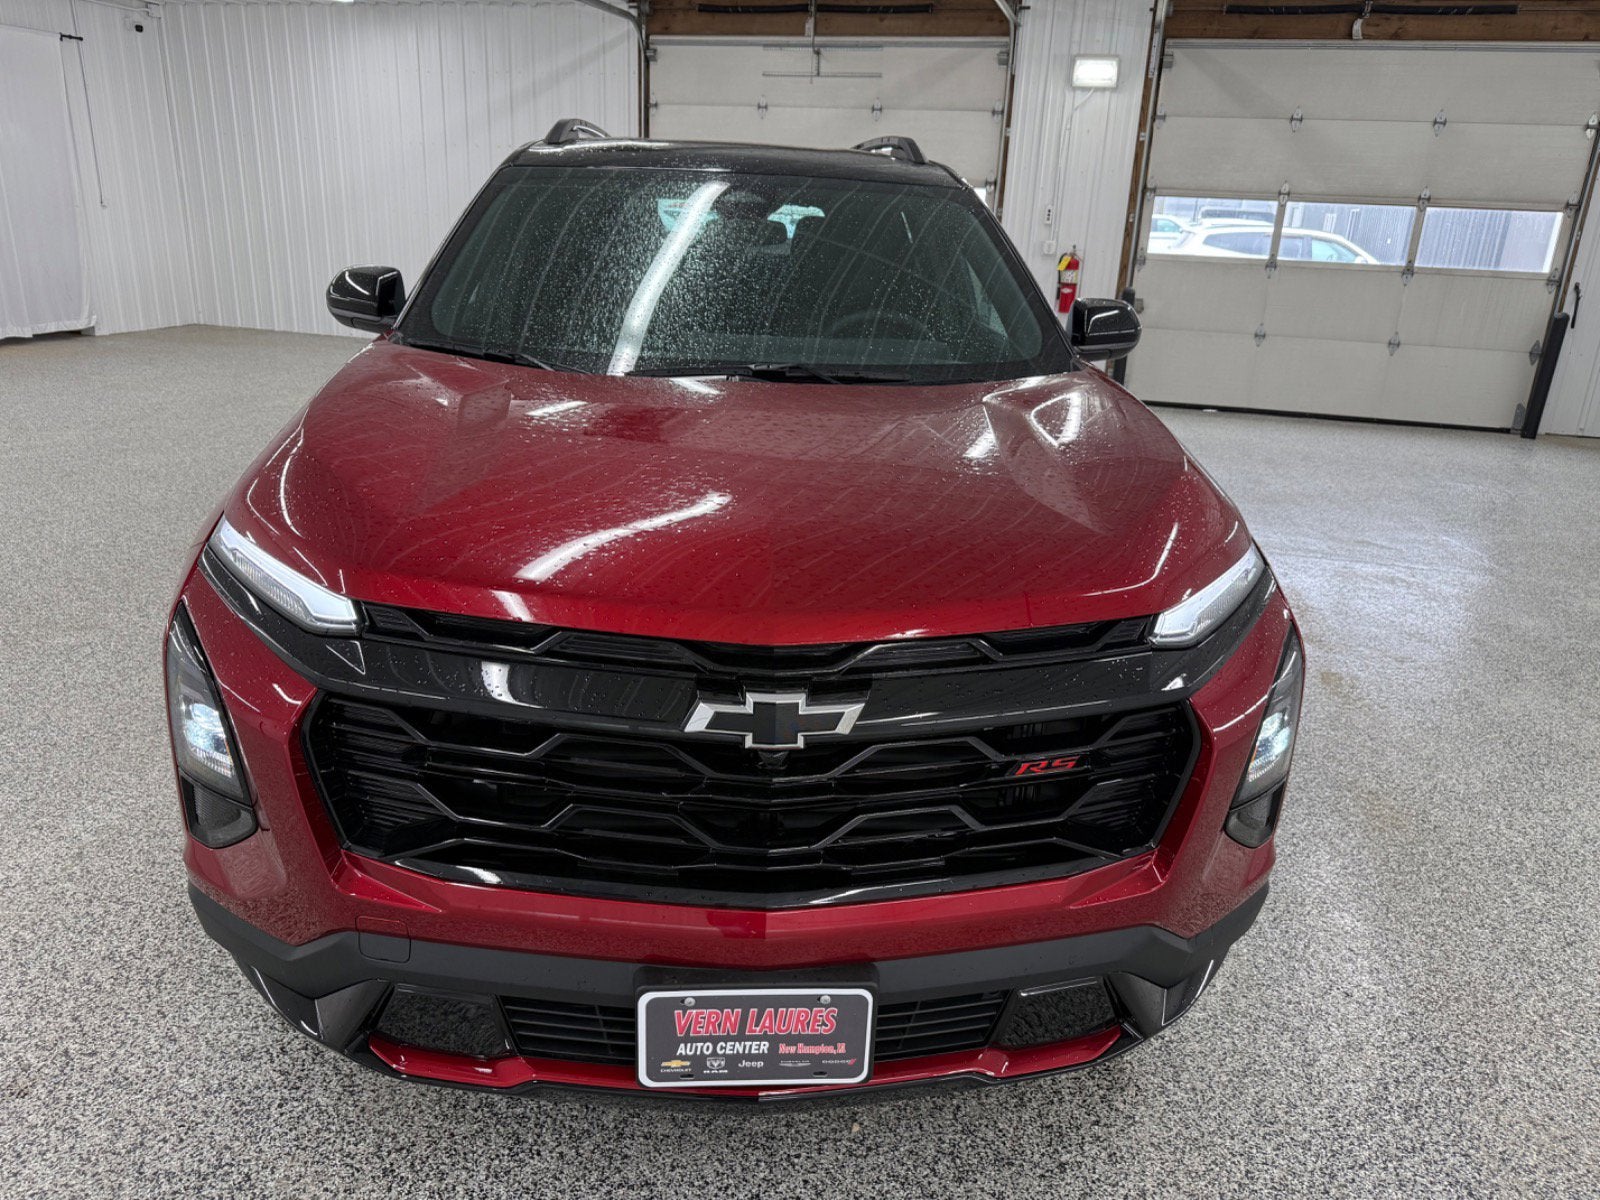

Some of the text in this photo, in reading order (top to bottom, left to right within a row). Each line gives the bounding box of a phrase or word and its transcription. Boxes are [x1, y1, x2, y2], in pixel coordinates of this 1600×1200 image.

[1015, 756, 1080, 775] RS
[674, 1007, 838, 1036] VERN LAURES
[676, 1041, 769, 1055] AUTO CENTER
[779, 1043, 796, 1054] New
[738, 1060, 764, 1068] Jeep
